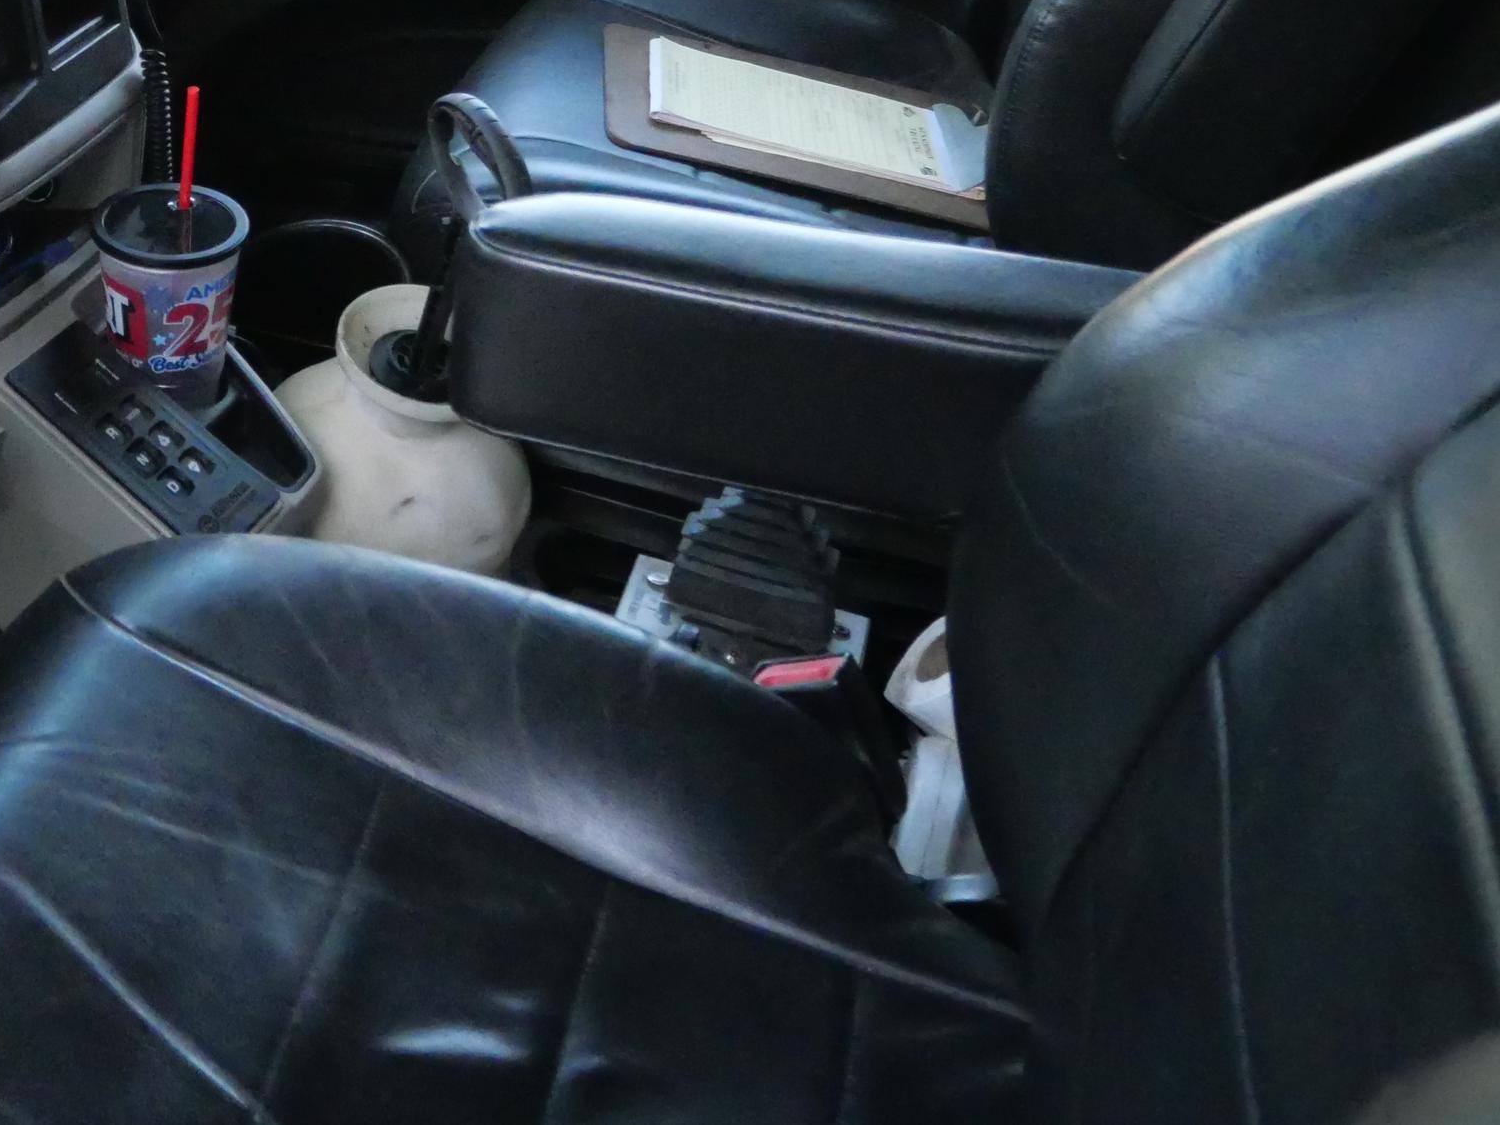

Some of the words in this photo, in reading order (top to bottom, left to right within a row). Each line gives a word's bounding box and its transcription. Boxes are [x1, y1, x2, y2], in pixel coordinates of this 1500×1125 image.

[150, 354, 190, 373] Best
[105, 427, 119, 440] R
[166, 480, 180, 493] D
